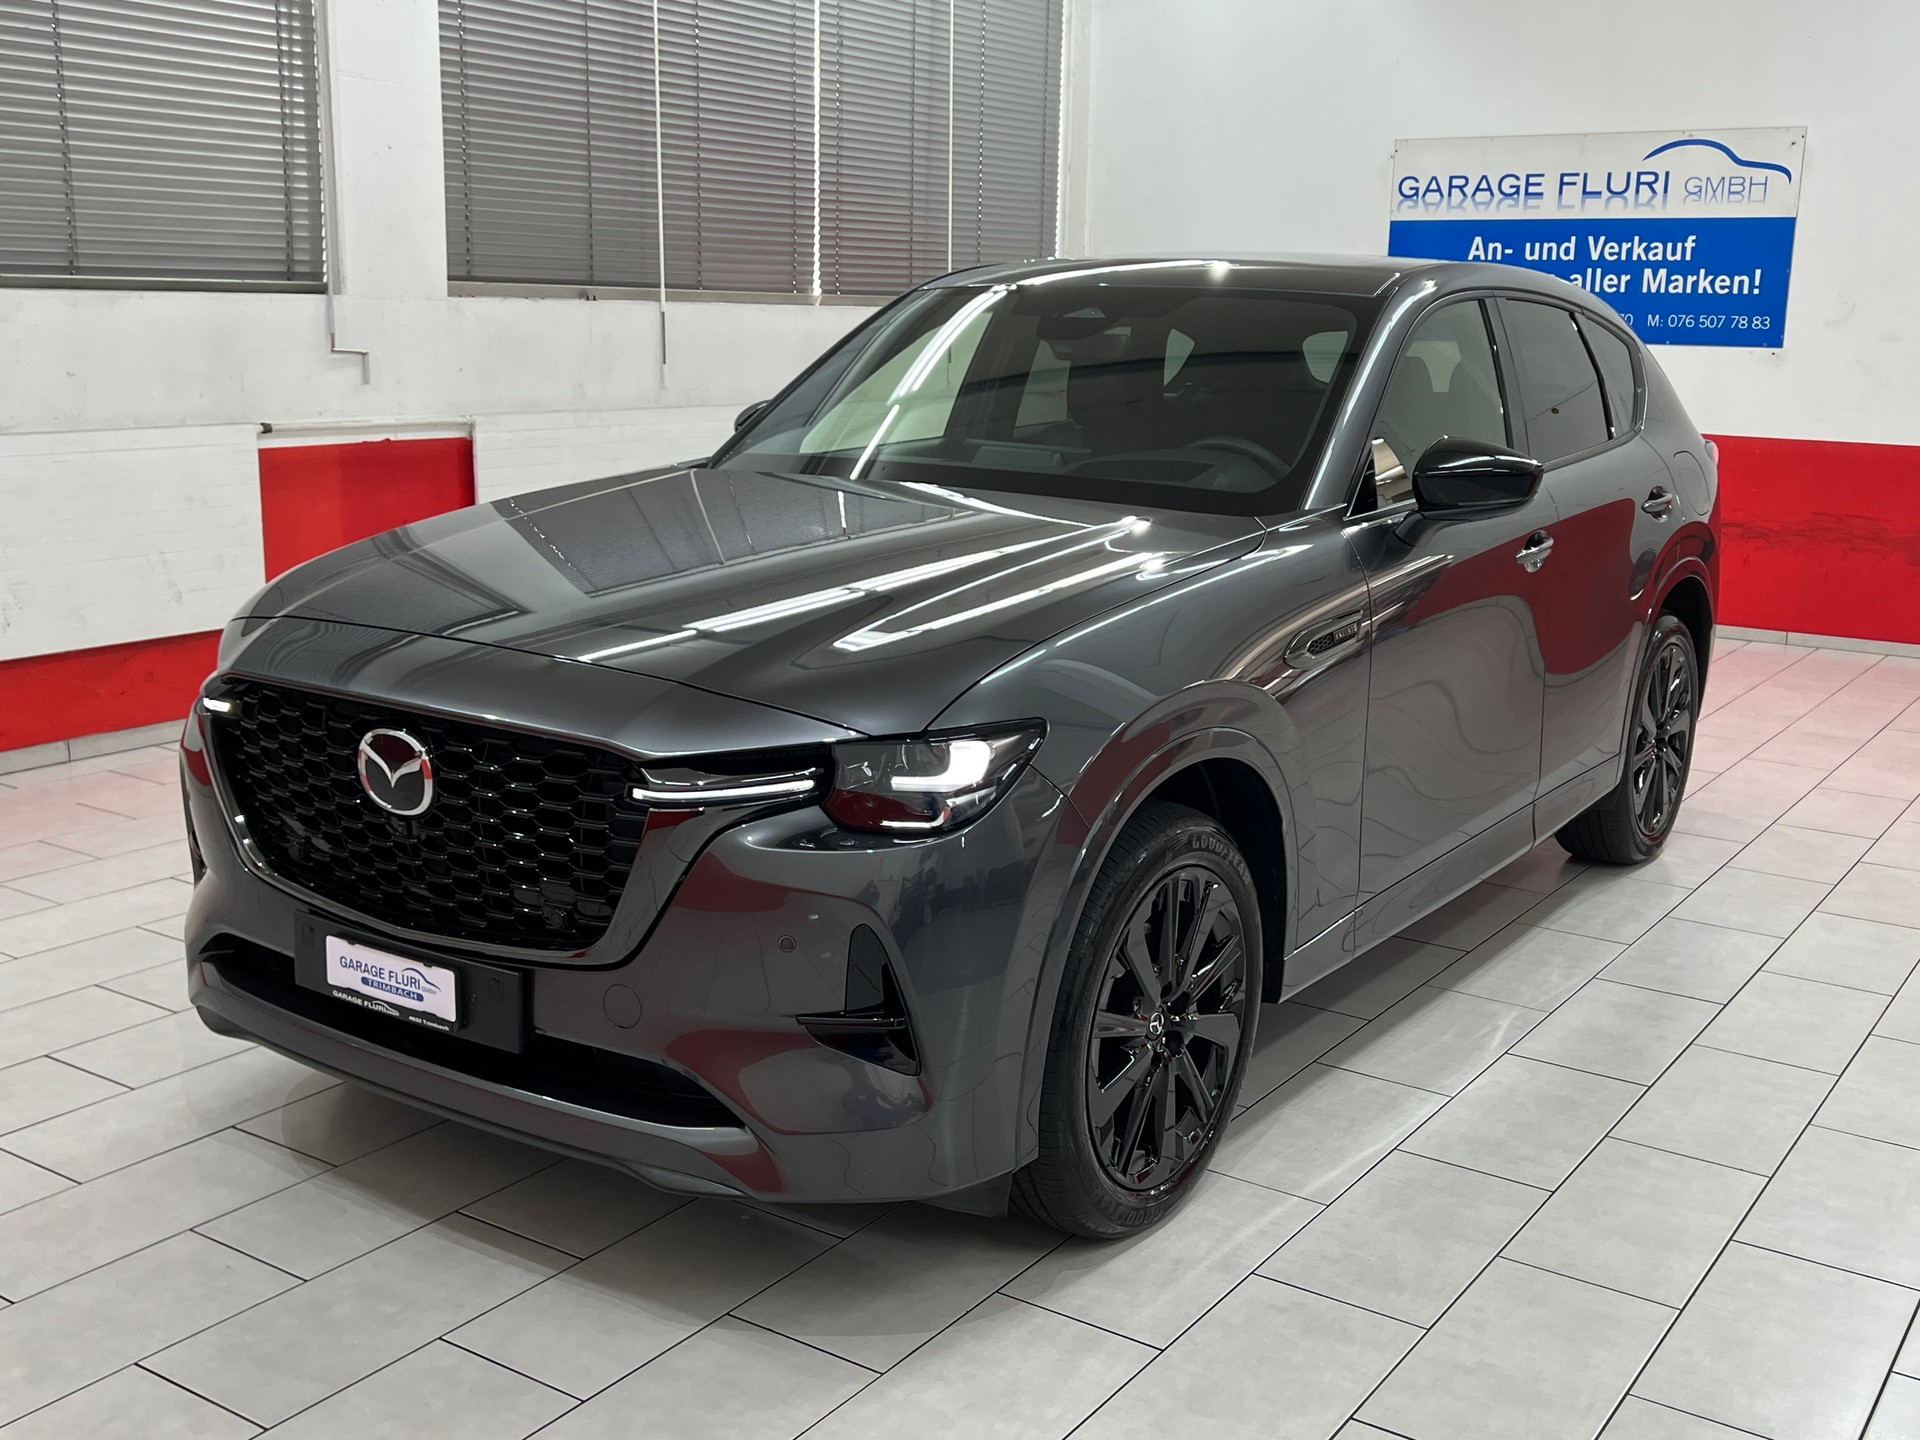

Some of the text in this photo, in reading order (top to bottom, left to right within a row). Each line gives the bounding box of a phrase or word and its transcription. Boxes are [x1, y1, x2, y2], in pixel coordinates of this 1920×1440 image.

[1397, 170, 1768, 200] GARAGE FLURI GMBH
[1467, 234, 1697, 261] An- und Verkauf
[1569, 267, 1763, 295] aller Marken!
[1647, 314, 1664, 327] M:
[1668, 314, 1695, 328] 076
[1698, 315, 1726, 329] 507
[1731, 315, 1749, 330] 78
[1752, 316, 1770, 330] 83
[339, 955, 386, 980] GARAGE
[388, 970, 421, 991] FLURI
[332, 989, 363, 1006] GARAGE
[363, 1000, 387, 1013] FLURI
[367, 979, 418, 1000] TRIMBACH
